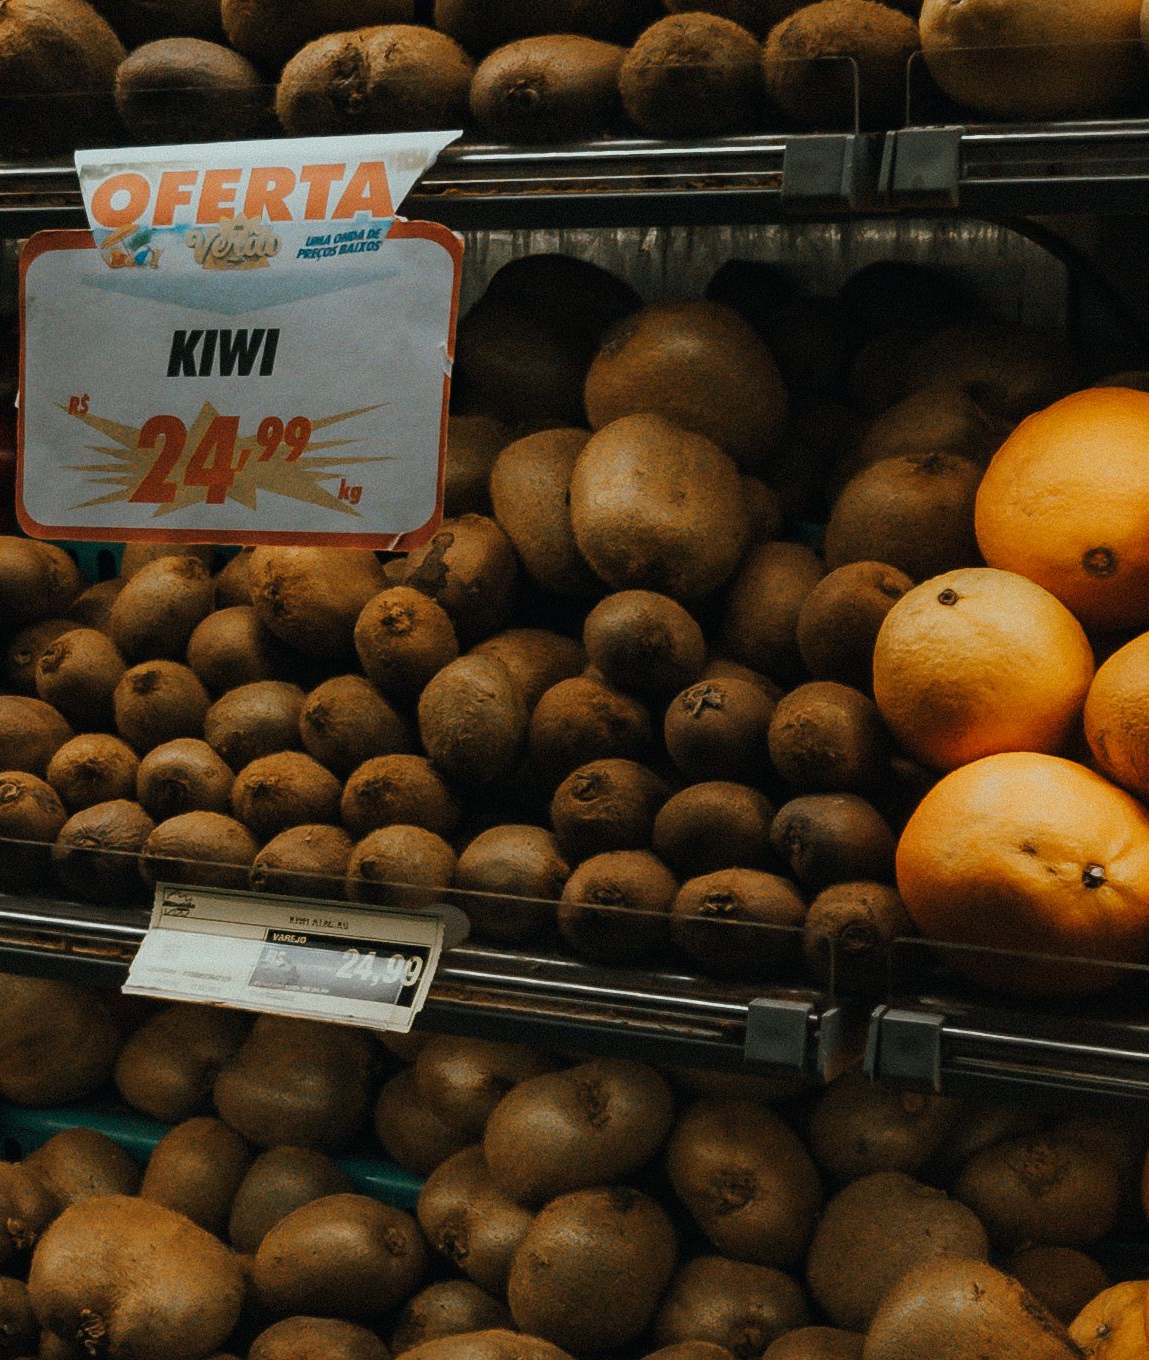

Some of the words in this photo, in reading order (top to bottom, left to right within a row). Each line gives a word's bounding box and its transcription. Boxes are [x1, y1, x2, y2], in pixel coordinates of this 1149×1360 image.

[91, 161, 396, 229] OFERTA
[305, 235, 331, 246] UMA
[333, 231, 365, 244] ONDA
[367, 228, 382, 240] DE
[296, 246, 339, 261] PREÇOS
[338, 240, 382, 255] BAIXOS
[166, 328, 281, 377] KIWI
[67, 393, 90, 415] R$
[338, 477, 363, 505] kg
[272, 932, 307, 945] VAREJO
[336, 948, 425, 987] 24,99
